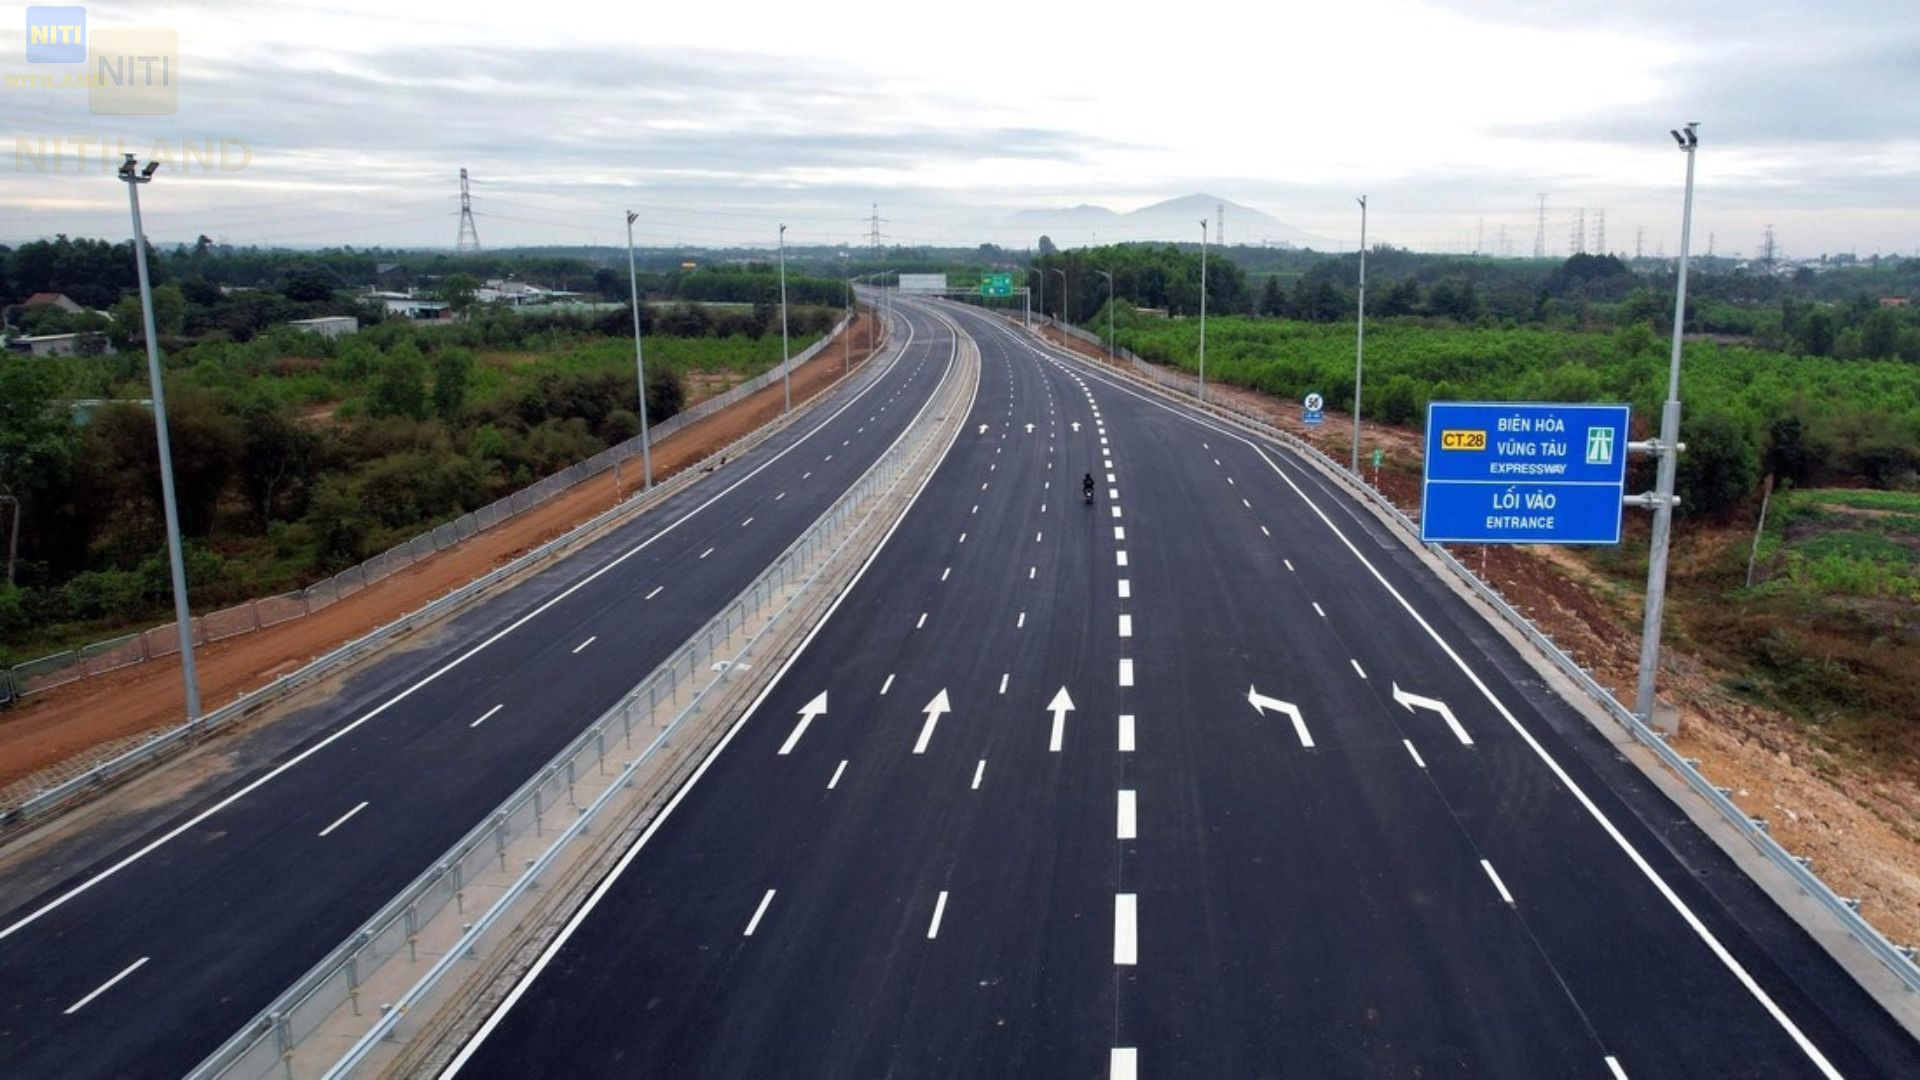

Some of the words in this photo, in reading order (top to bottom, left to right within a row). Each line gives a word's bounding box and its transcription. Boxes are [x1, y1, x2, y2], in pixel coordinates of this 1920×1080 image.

[1497, 414, 1530, 432] BIÊN
[1535, 414, 1565, 432] HÒA
[1443, 433, 1485, 447] CT.28
[1497, 439, 1536, 456] VŨNG
[1541, 440, 1567, 456] TÀU
[1490, 462, 1567, 474] EXPRESSWAY
[1493, 485, 1520, 509] LỐI
[1525, 489, 1556, 509] VÀO
[1486, 516, 1555, 529] ENTRANCE
